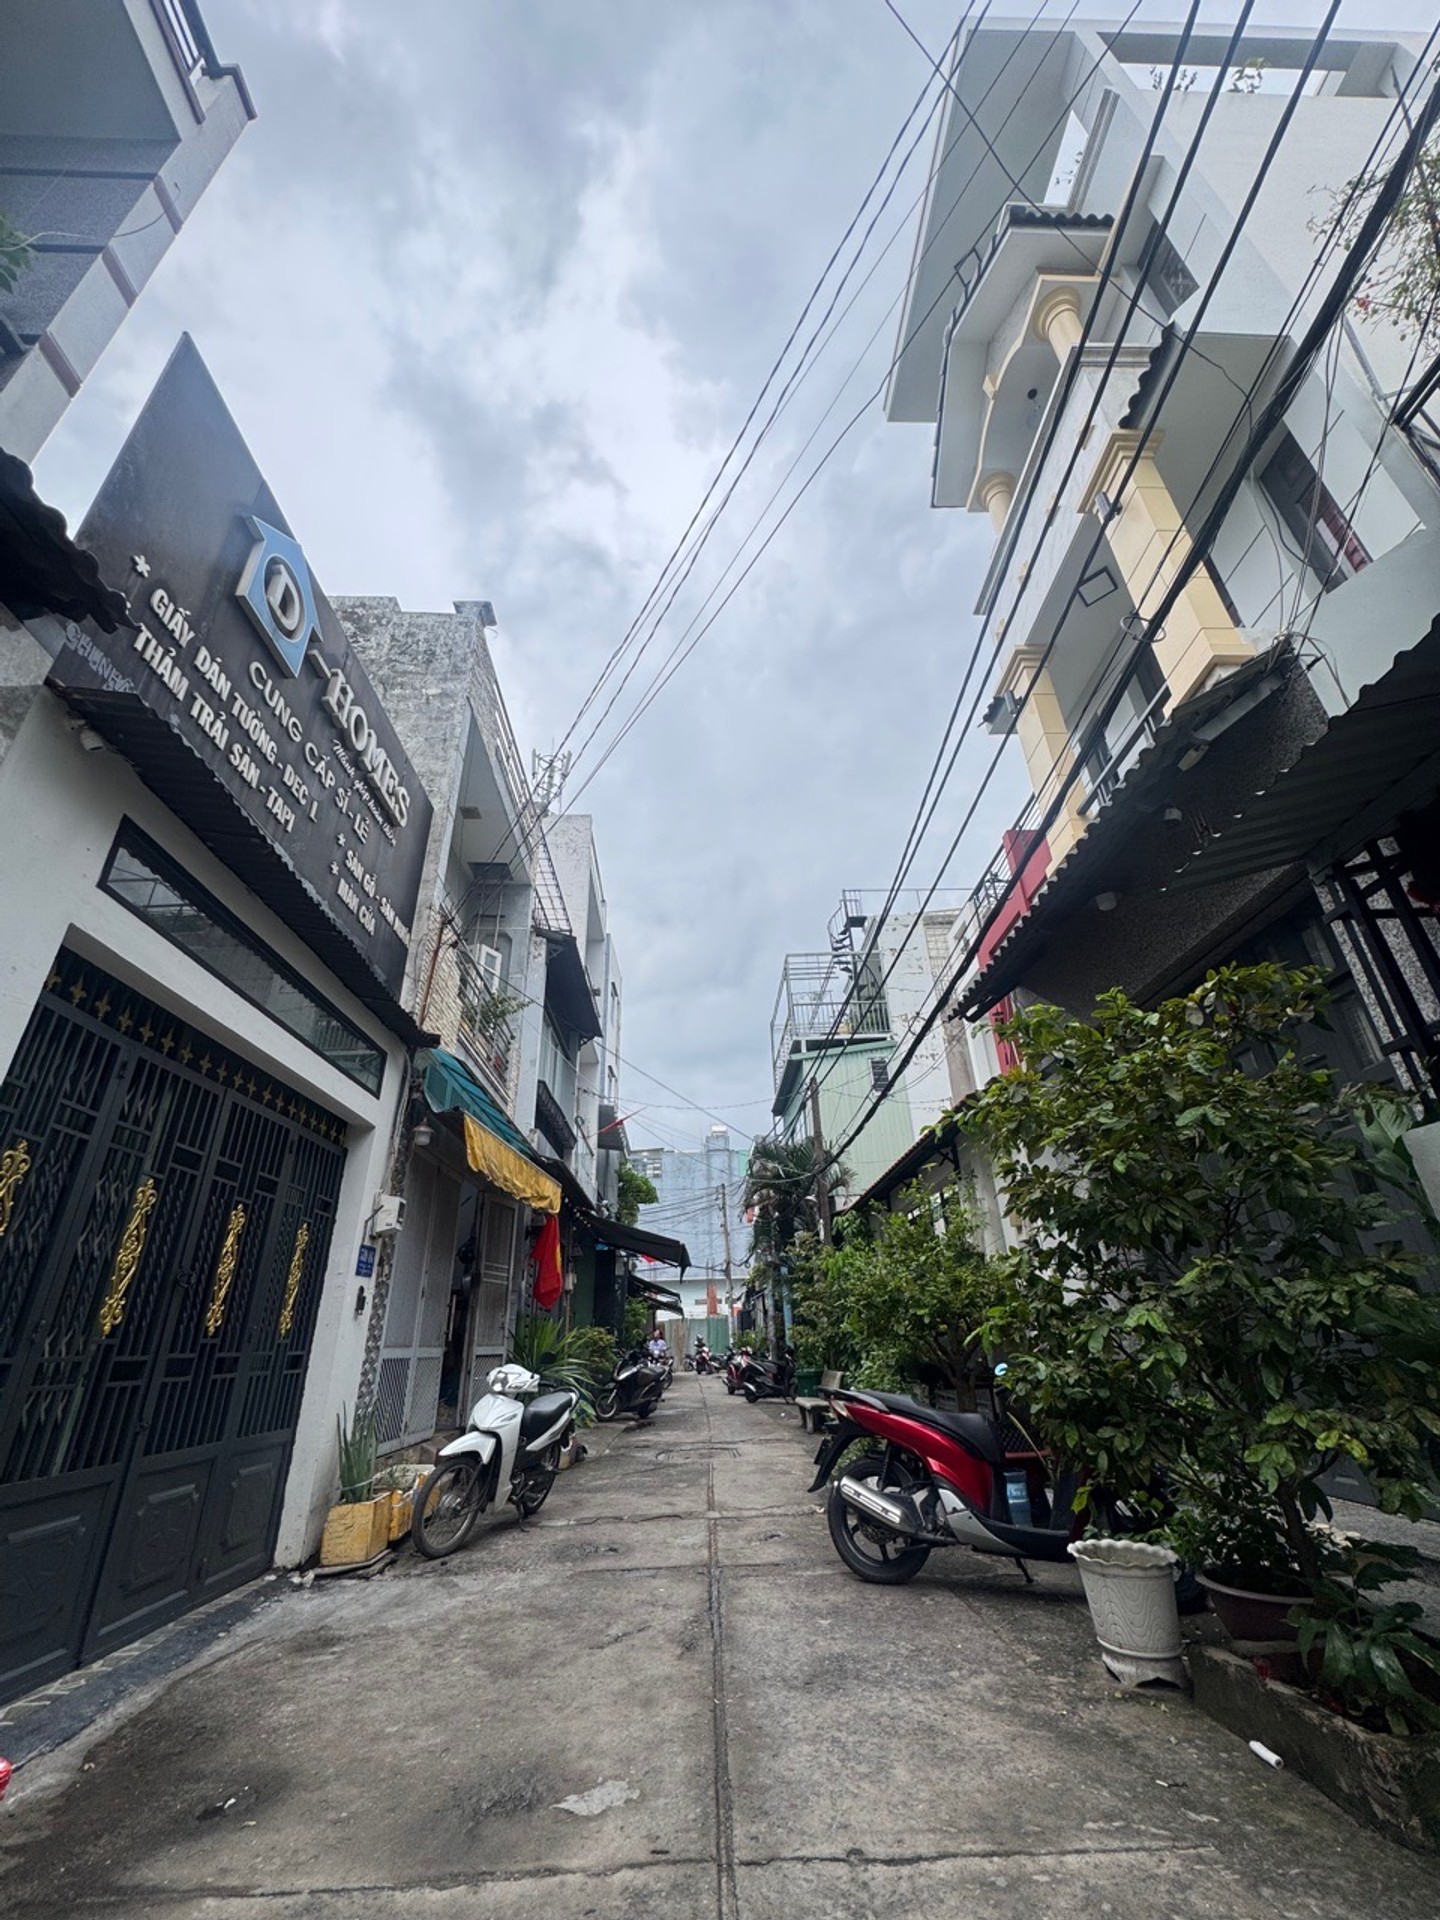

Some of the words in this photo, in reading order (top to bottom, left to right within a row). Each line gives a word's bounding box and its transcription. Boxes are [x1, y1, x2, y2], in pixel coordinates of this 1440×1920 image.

[266, 564, 301, 632] D
[133, 622, 189, 702] THẢM
[190, 691, 230, 750] TRẢI
[229, 743, 261, 789] SÀN
[265, 786, 296, 833] TAPI
[150, 588, 196, 649] GIẤY
[194, 646, 232, 702] DÁN
[231, 692, 278, 765] TƯỜNG
[282, 764, 309, 806] DEC
[250, 661, 303, 742] CUNG
[305, 742, 336, 789] CẤP
[354, 814, 369, 844] LẺ
